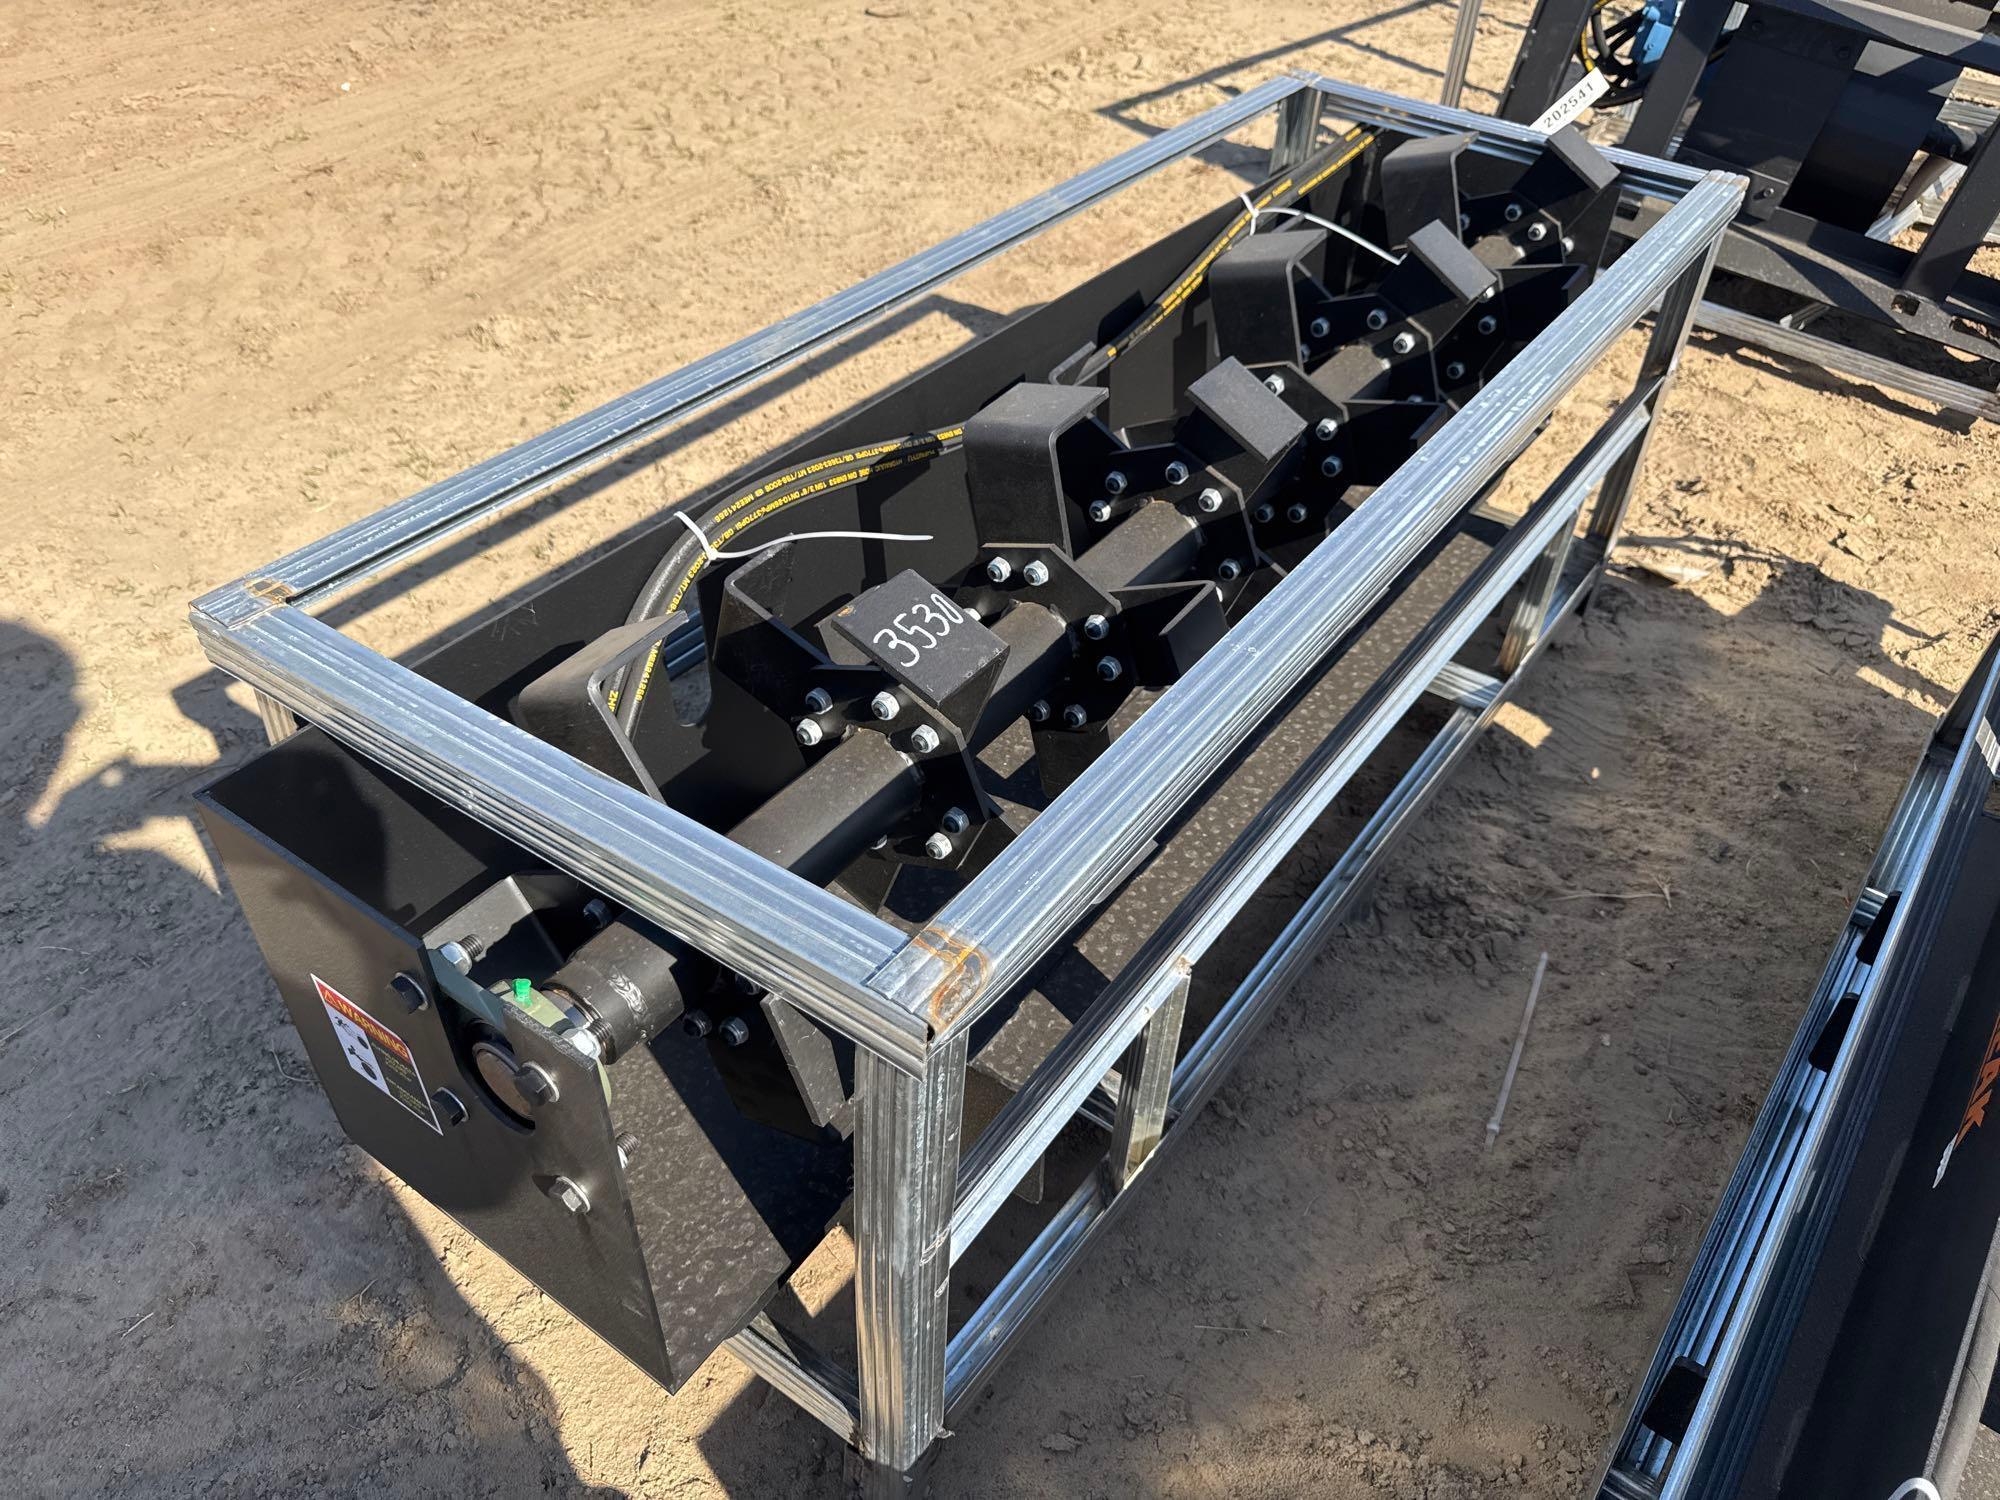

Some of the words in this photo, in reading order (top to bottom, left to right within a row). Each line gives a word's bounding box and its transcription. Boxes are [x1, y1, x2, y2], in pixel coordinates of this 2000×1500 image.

[1543, 81, 1594, 128] 202541
[873, 593, 964, 668] 3530
[338, 1001, 408, 1057] WARNING
